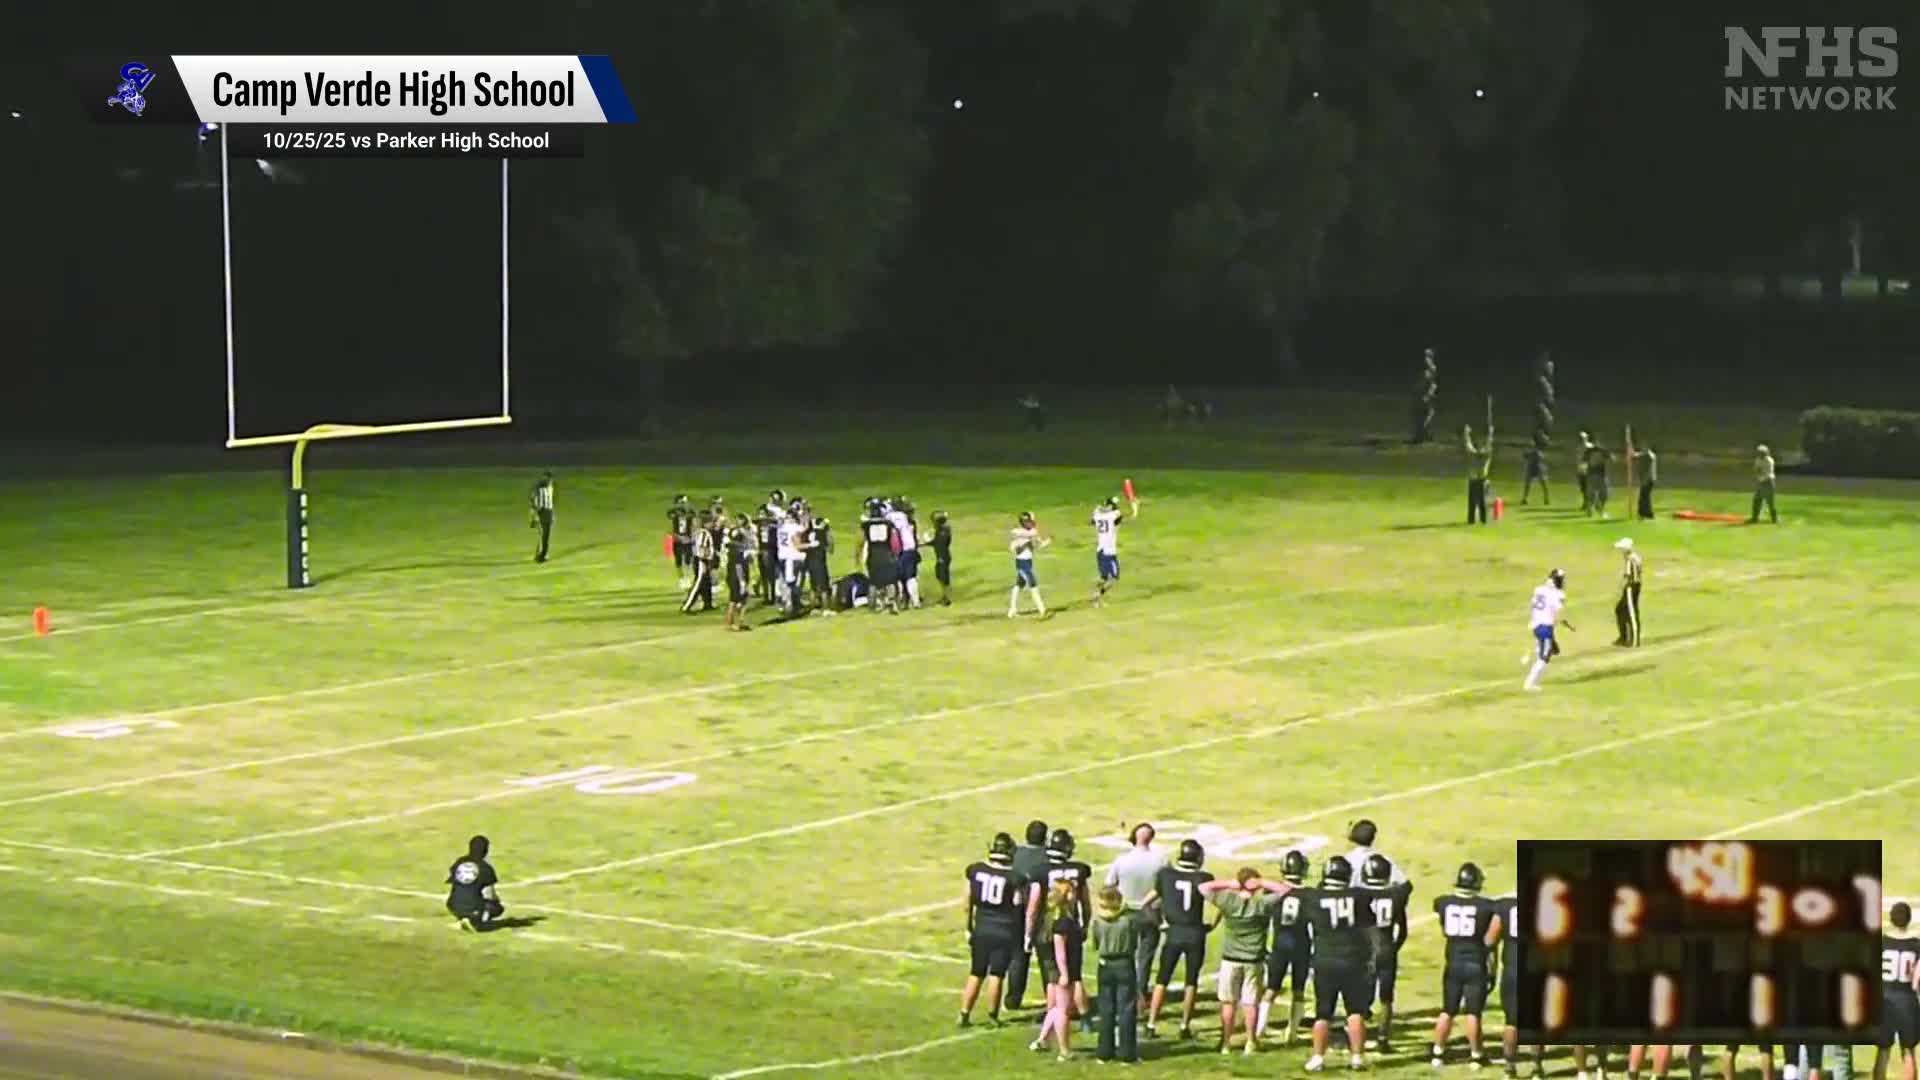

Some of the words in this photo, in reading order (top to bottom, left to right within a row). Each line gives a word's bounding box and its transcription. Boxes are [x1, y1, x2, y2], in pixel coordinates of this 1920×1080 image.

[503, 765, 697, 796] 10
[975, 871, 1006, 905] 70
[1175, 880, 1193, 912] 7
[1320, 895, 1355, 928] 74
[1537, 878, 1567, 940] 6
[1612, 887, 1640, 936] 2
[1757, 886, 1782, 936] 3
